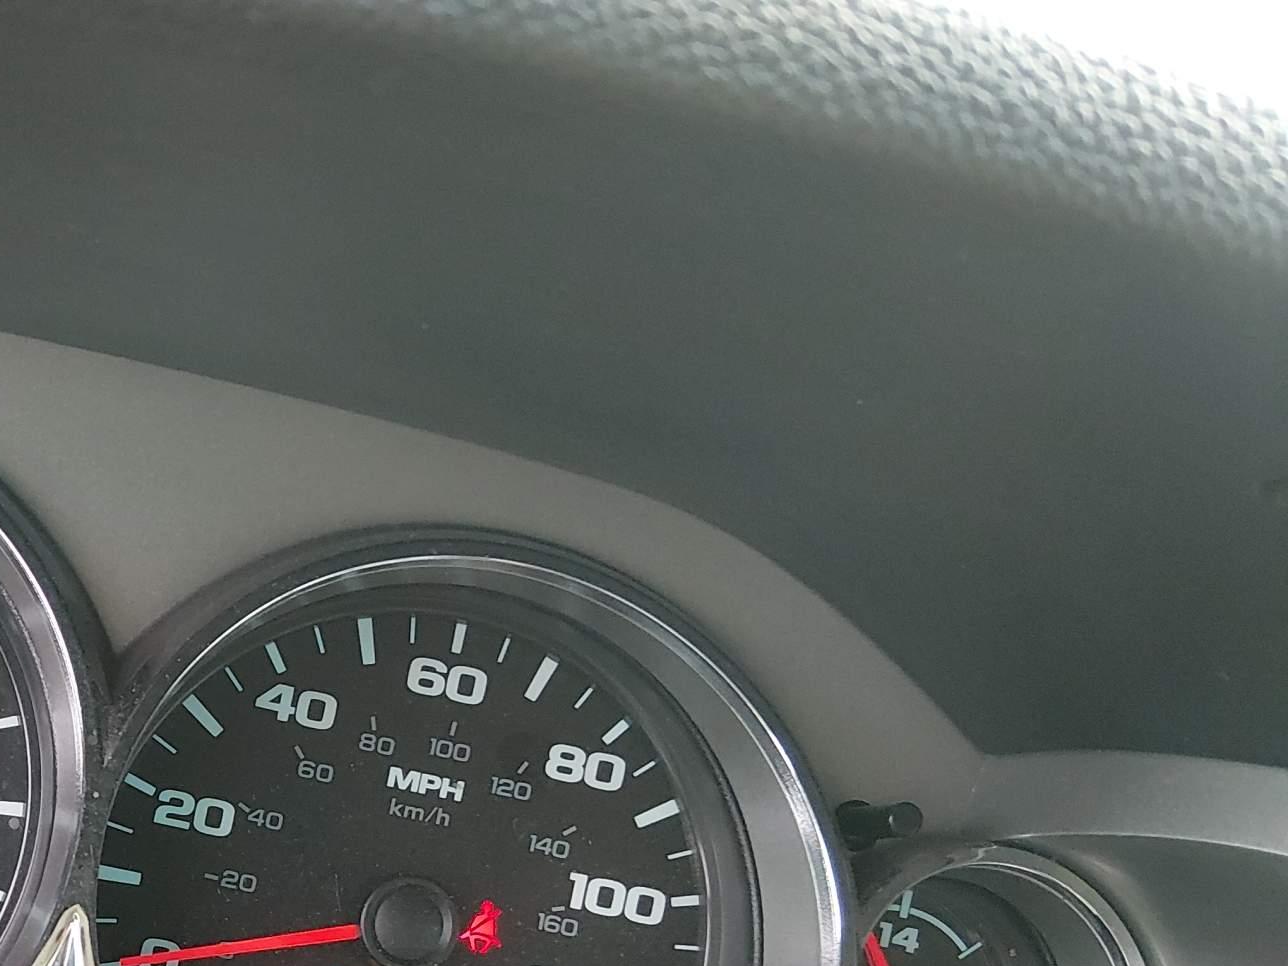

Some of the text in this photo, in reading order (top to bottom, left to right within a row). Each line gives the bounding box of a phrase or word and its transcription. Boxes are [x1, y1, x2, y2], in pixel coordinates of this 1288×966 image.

[405, 656, 488, 706] 60
[254, 683, 338, 731] 40
[358, 733, 396, 757] 80
[429, 737, 472, 763] 100
[296, 760, 335, 784] 60
[544, 743, 626, 792] 80
[386, 765, 466, 803] MPH
[490, 775, 533, 802] 120
[152, 789, 236, 838] 20
[247, 807, 285, 832] 40
[389, 798, 451, 828] km/h
[528, 834, 571, 860] 140
[220, 869, 258, 894] 20
[568, 871, 666, 926] 100
[537, 912, 579, 938] 160
[879, 922, 920, 954] 14
